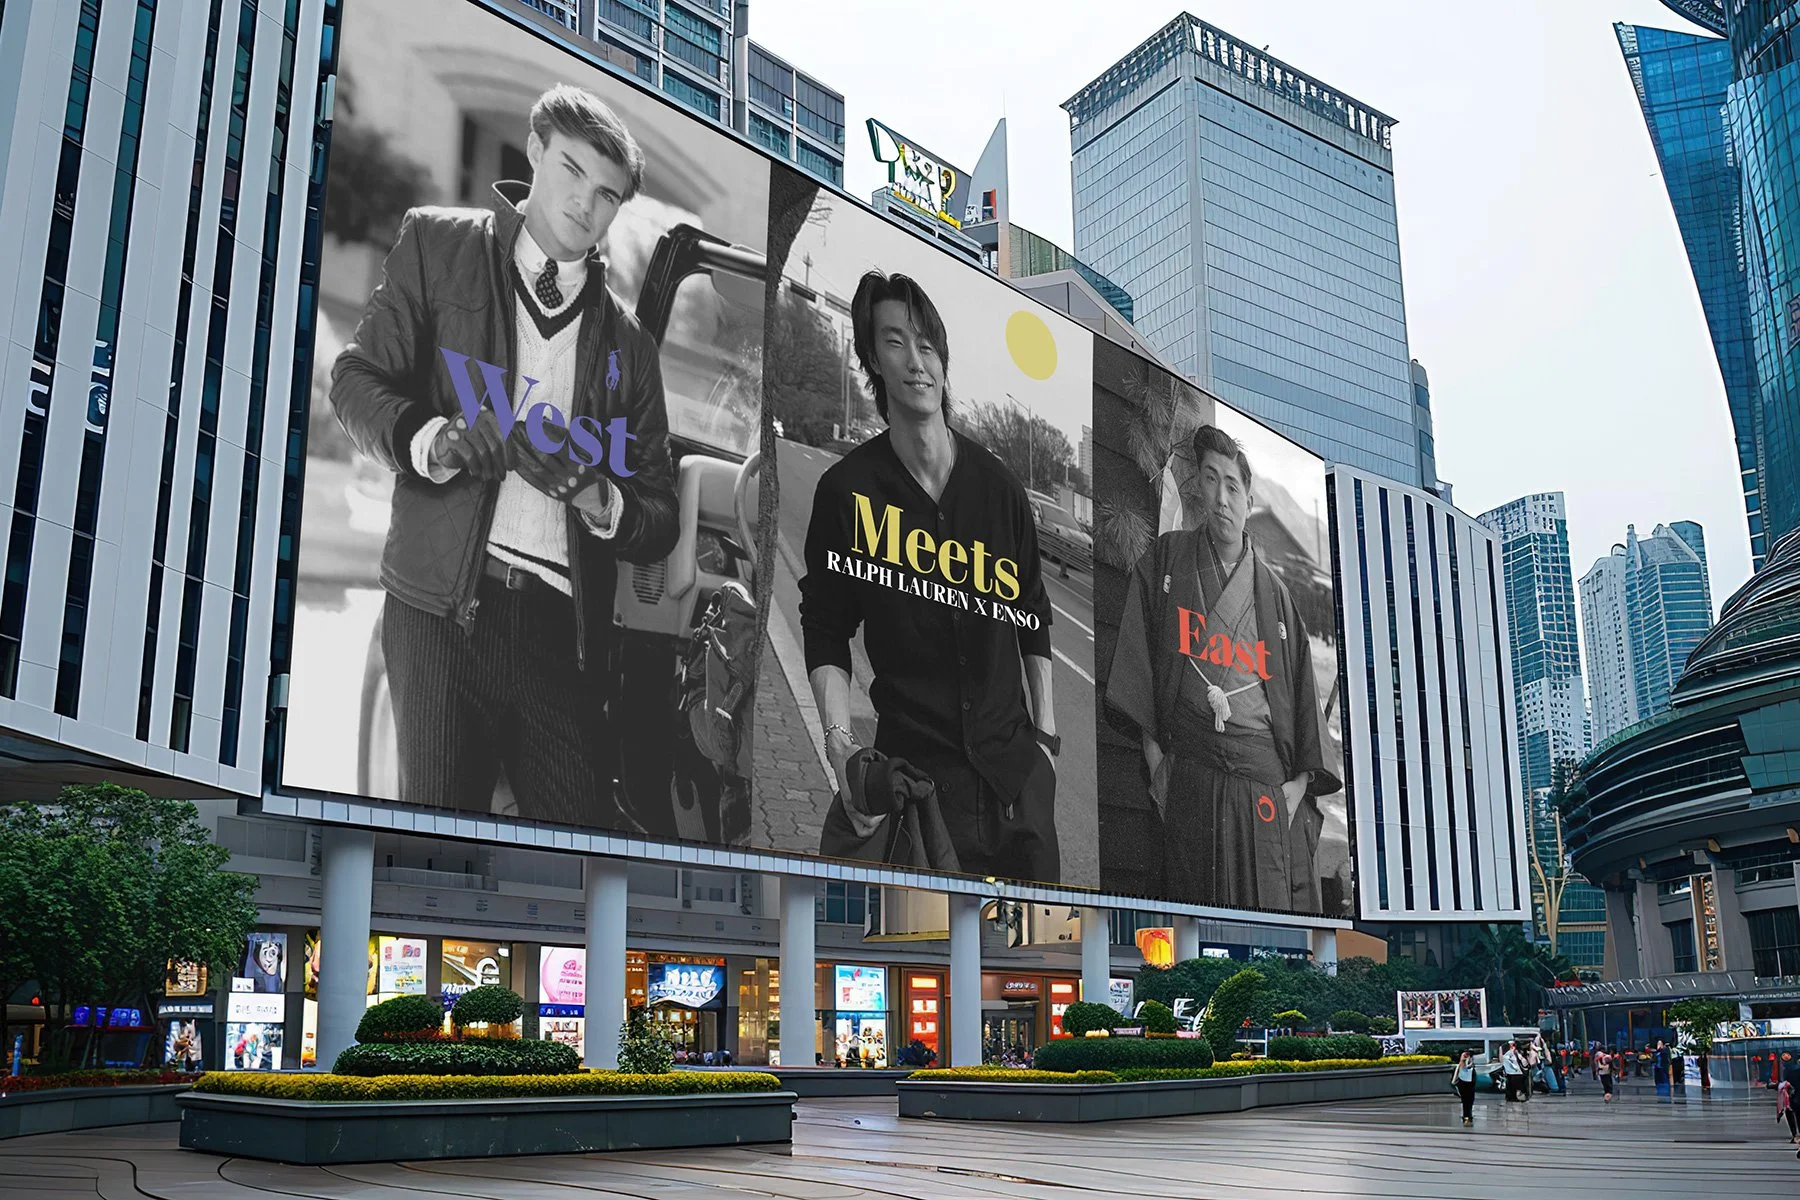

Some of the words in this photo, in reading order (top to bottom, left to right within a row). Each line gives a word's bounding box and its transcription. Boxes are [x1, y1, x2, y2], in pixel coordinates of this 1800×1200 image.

[438, 346, 640, 478] West
[827, 550, 893, 588] RALPH
[898, 572, 969, 611] LAUREN
[974, 597, 988, 617] X
[992, 602, 1041, 632] ENSO
[851, 492, 1020, 601] Meets
[1177, 606, 1273, 681] East
